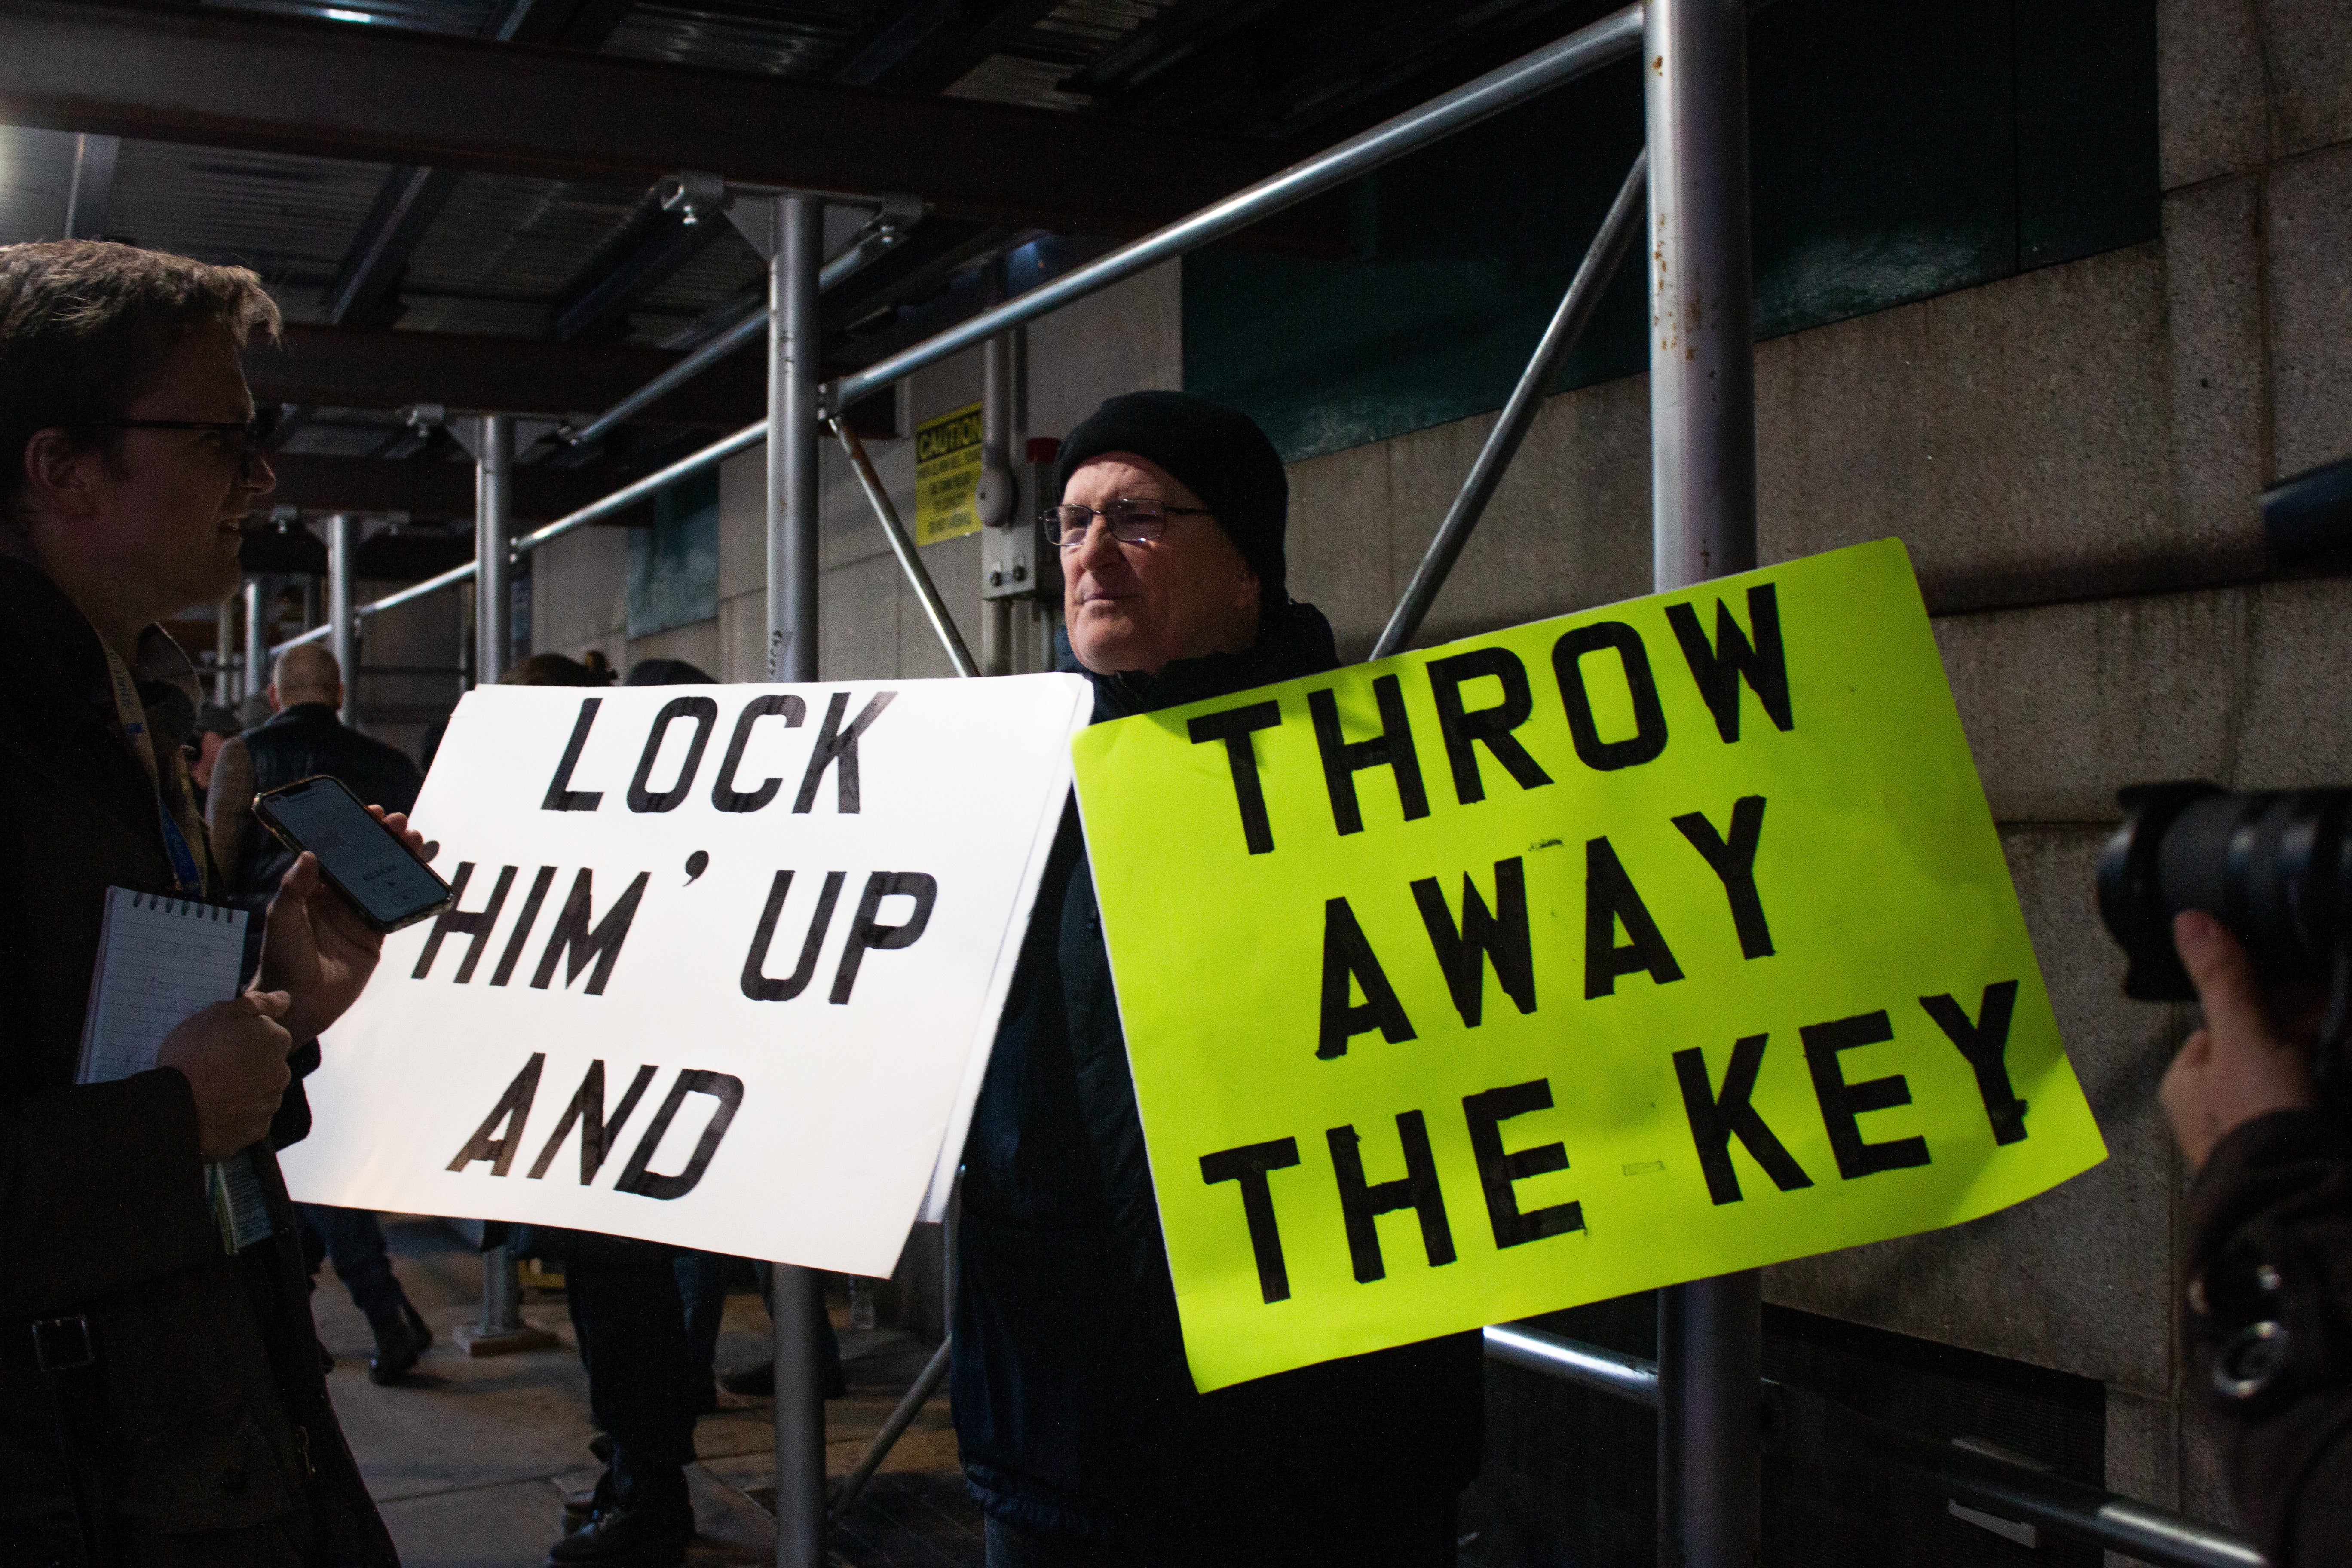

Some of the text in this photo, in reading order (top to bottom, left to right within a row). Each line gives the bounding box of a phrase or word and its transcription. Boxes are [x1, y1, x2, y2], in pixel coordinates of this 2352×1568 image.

[919, 413, 982, 459] CAUTION
[541, 691, 898, 814] LOCK
[1189, 582, 1795, 856] THROW
[411, 850, 937, 1005] HIM' UP
[1315, 794, 1777, 1060] AWAY
[447, 1052, 744, 1201] AND
[1198, 979, 2028, 1304] THE KEY
